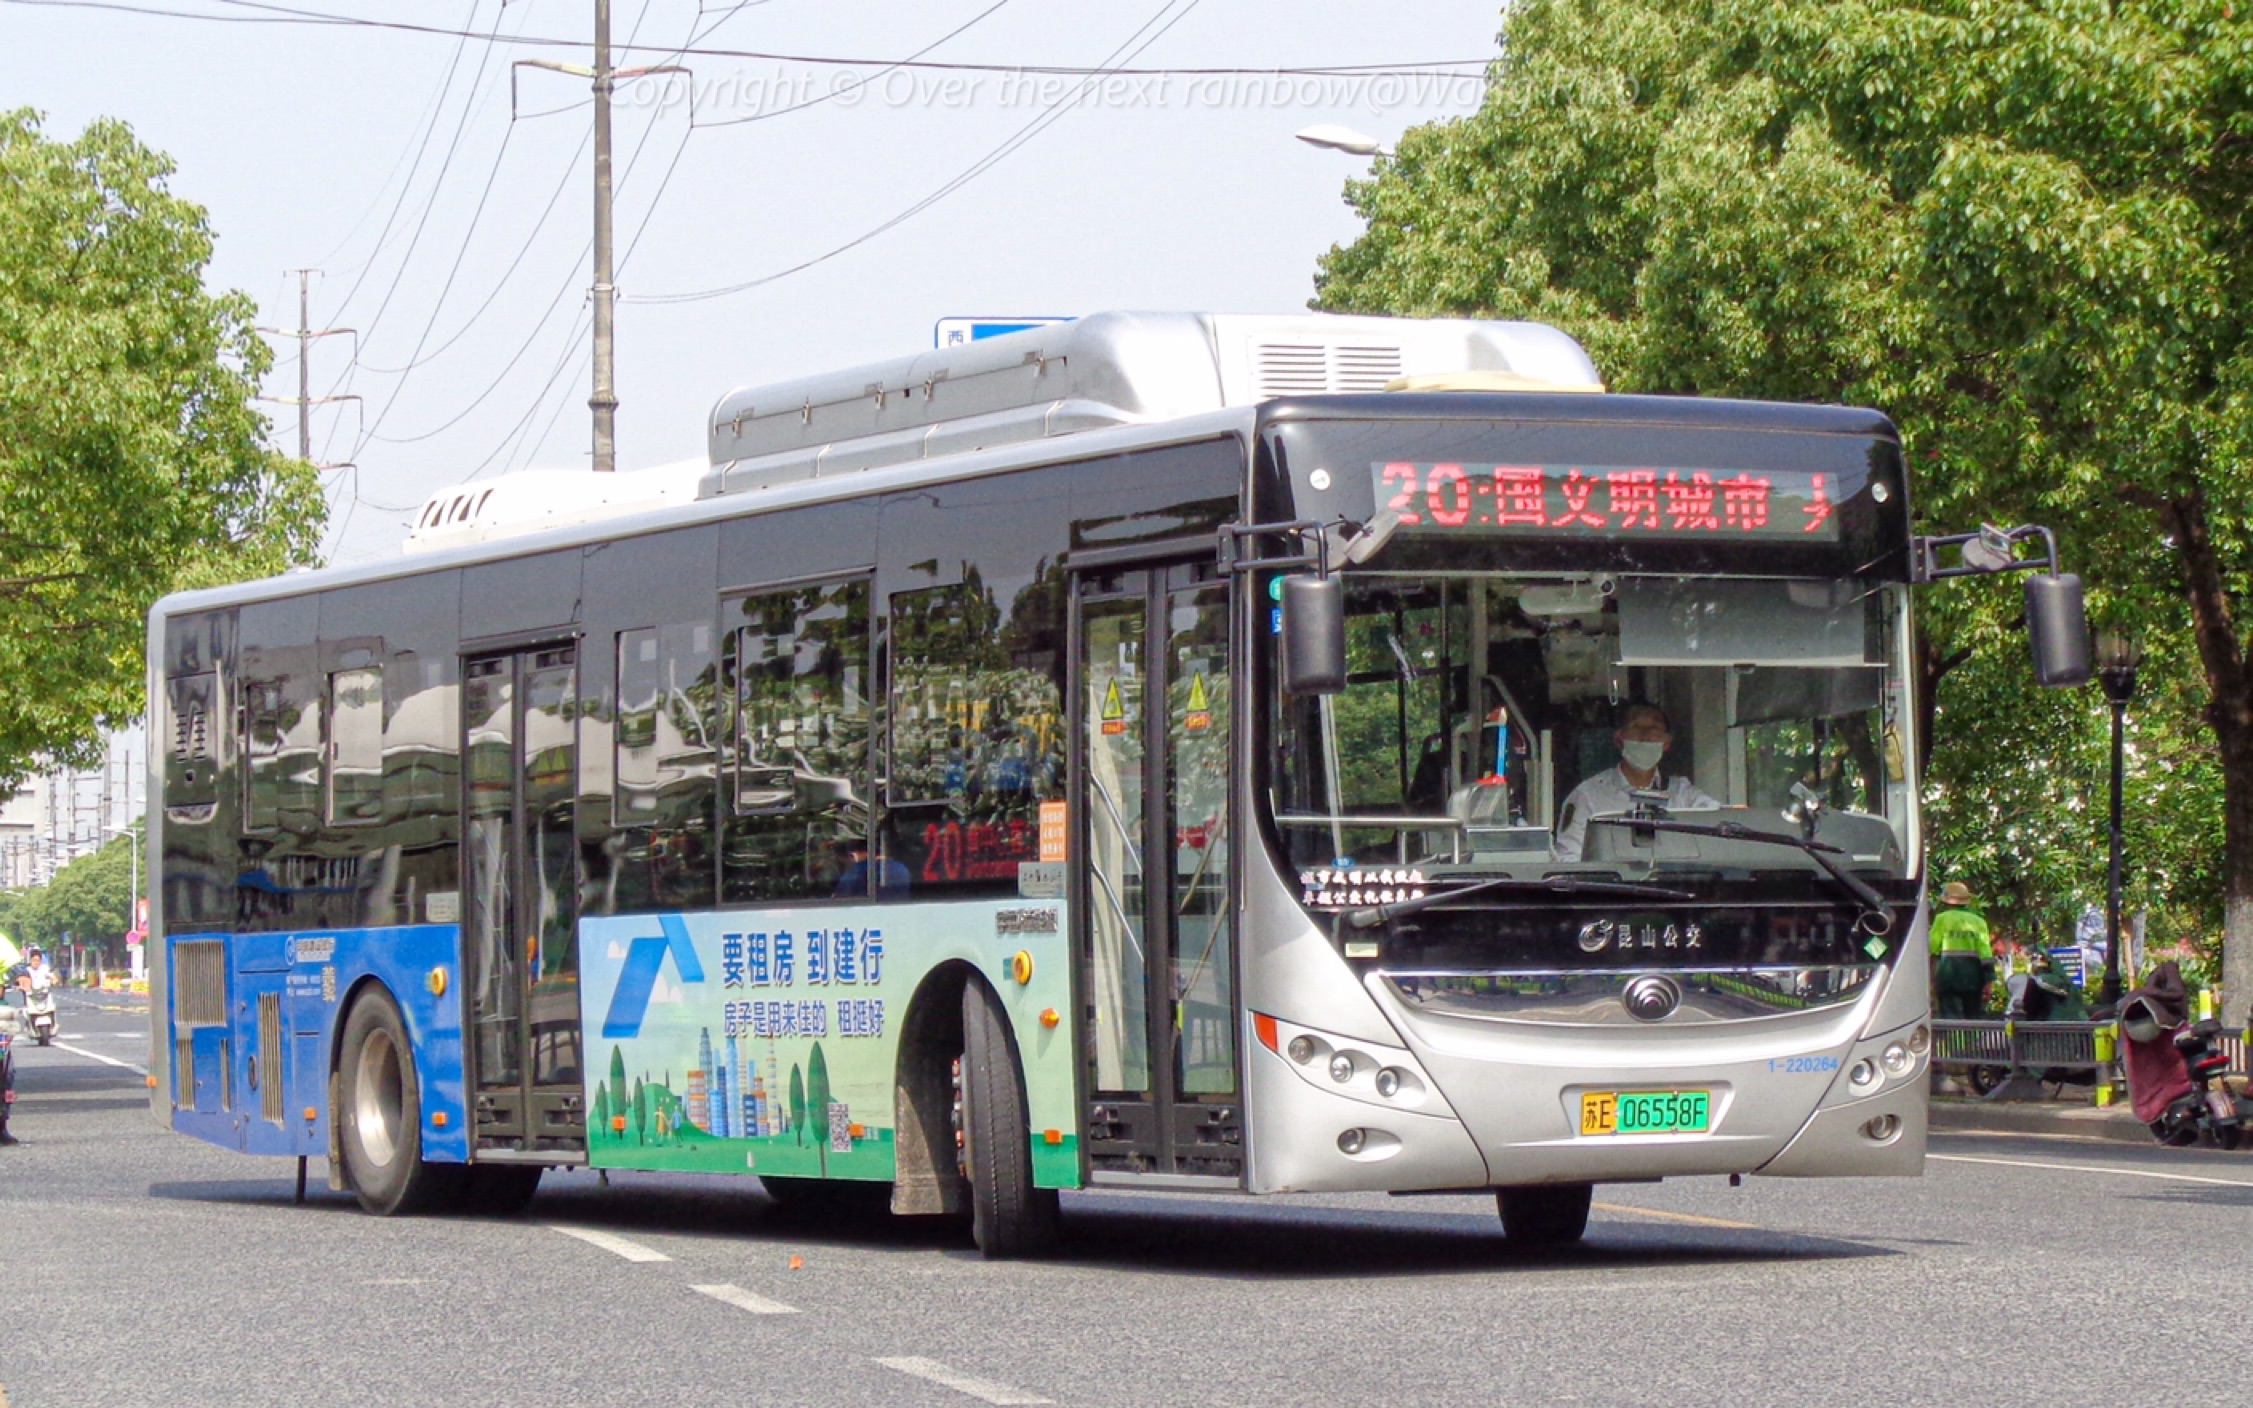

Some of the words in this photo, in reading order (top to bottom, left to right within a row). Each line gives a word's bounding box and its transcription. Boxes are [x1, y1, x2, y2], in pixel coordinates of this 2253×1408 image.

[922, 820, 963, 882] 20
[722, 929, 796, 988] 要租房
[805, 927, 885, 987] 到建行
[1617, 922, 1702, 949] 昆山公交
[723, 999, 828, 1039] 房子是用来住的
[837, 997, 885, 1039] 租挺好
